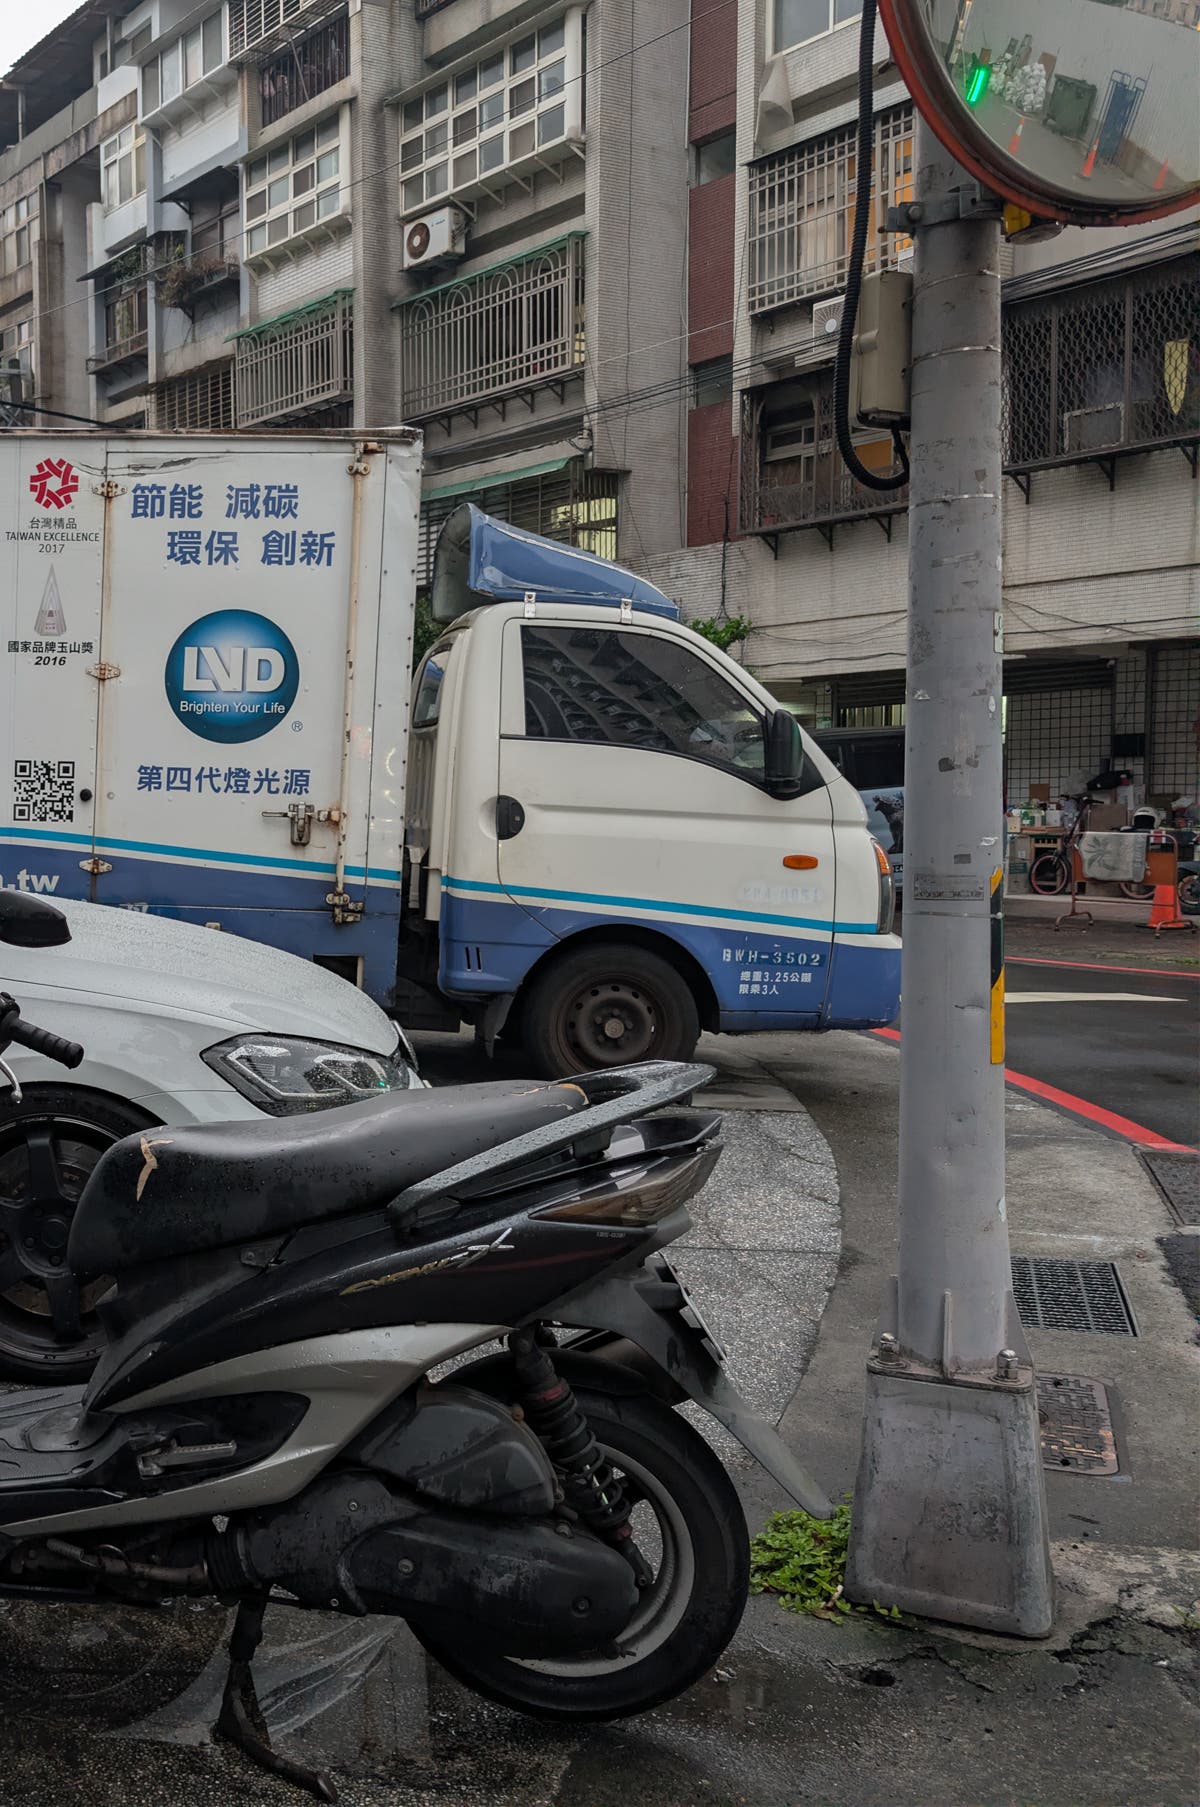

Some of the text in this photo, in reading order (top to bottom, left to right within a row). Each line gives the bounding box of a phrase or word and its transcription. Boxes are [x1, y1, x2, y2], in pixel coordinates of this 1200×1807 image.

[131, 483, 299, 519] 節能 減碳
[29, 516, 77, 529] 台灣精品
[5, 531, 100, 542] TAIWAN EXCELLENCE
[38, 543, 65, 553] 2017
[166, 530, 336, 566] 環保 創新
[7, 641, 93, 654] 國家品牌玉山獎
[34, 656, 67, 666] 2016
[180, 701, 286, 715] Brighten Your Life
[136, 765, 311, 796] 第四代燈光源
[722, 948, 820, 966] BWH-3502
